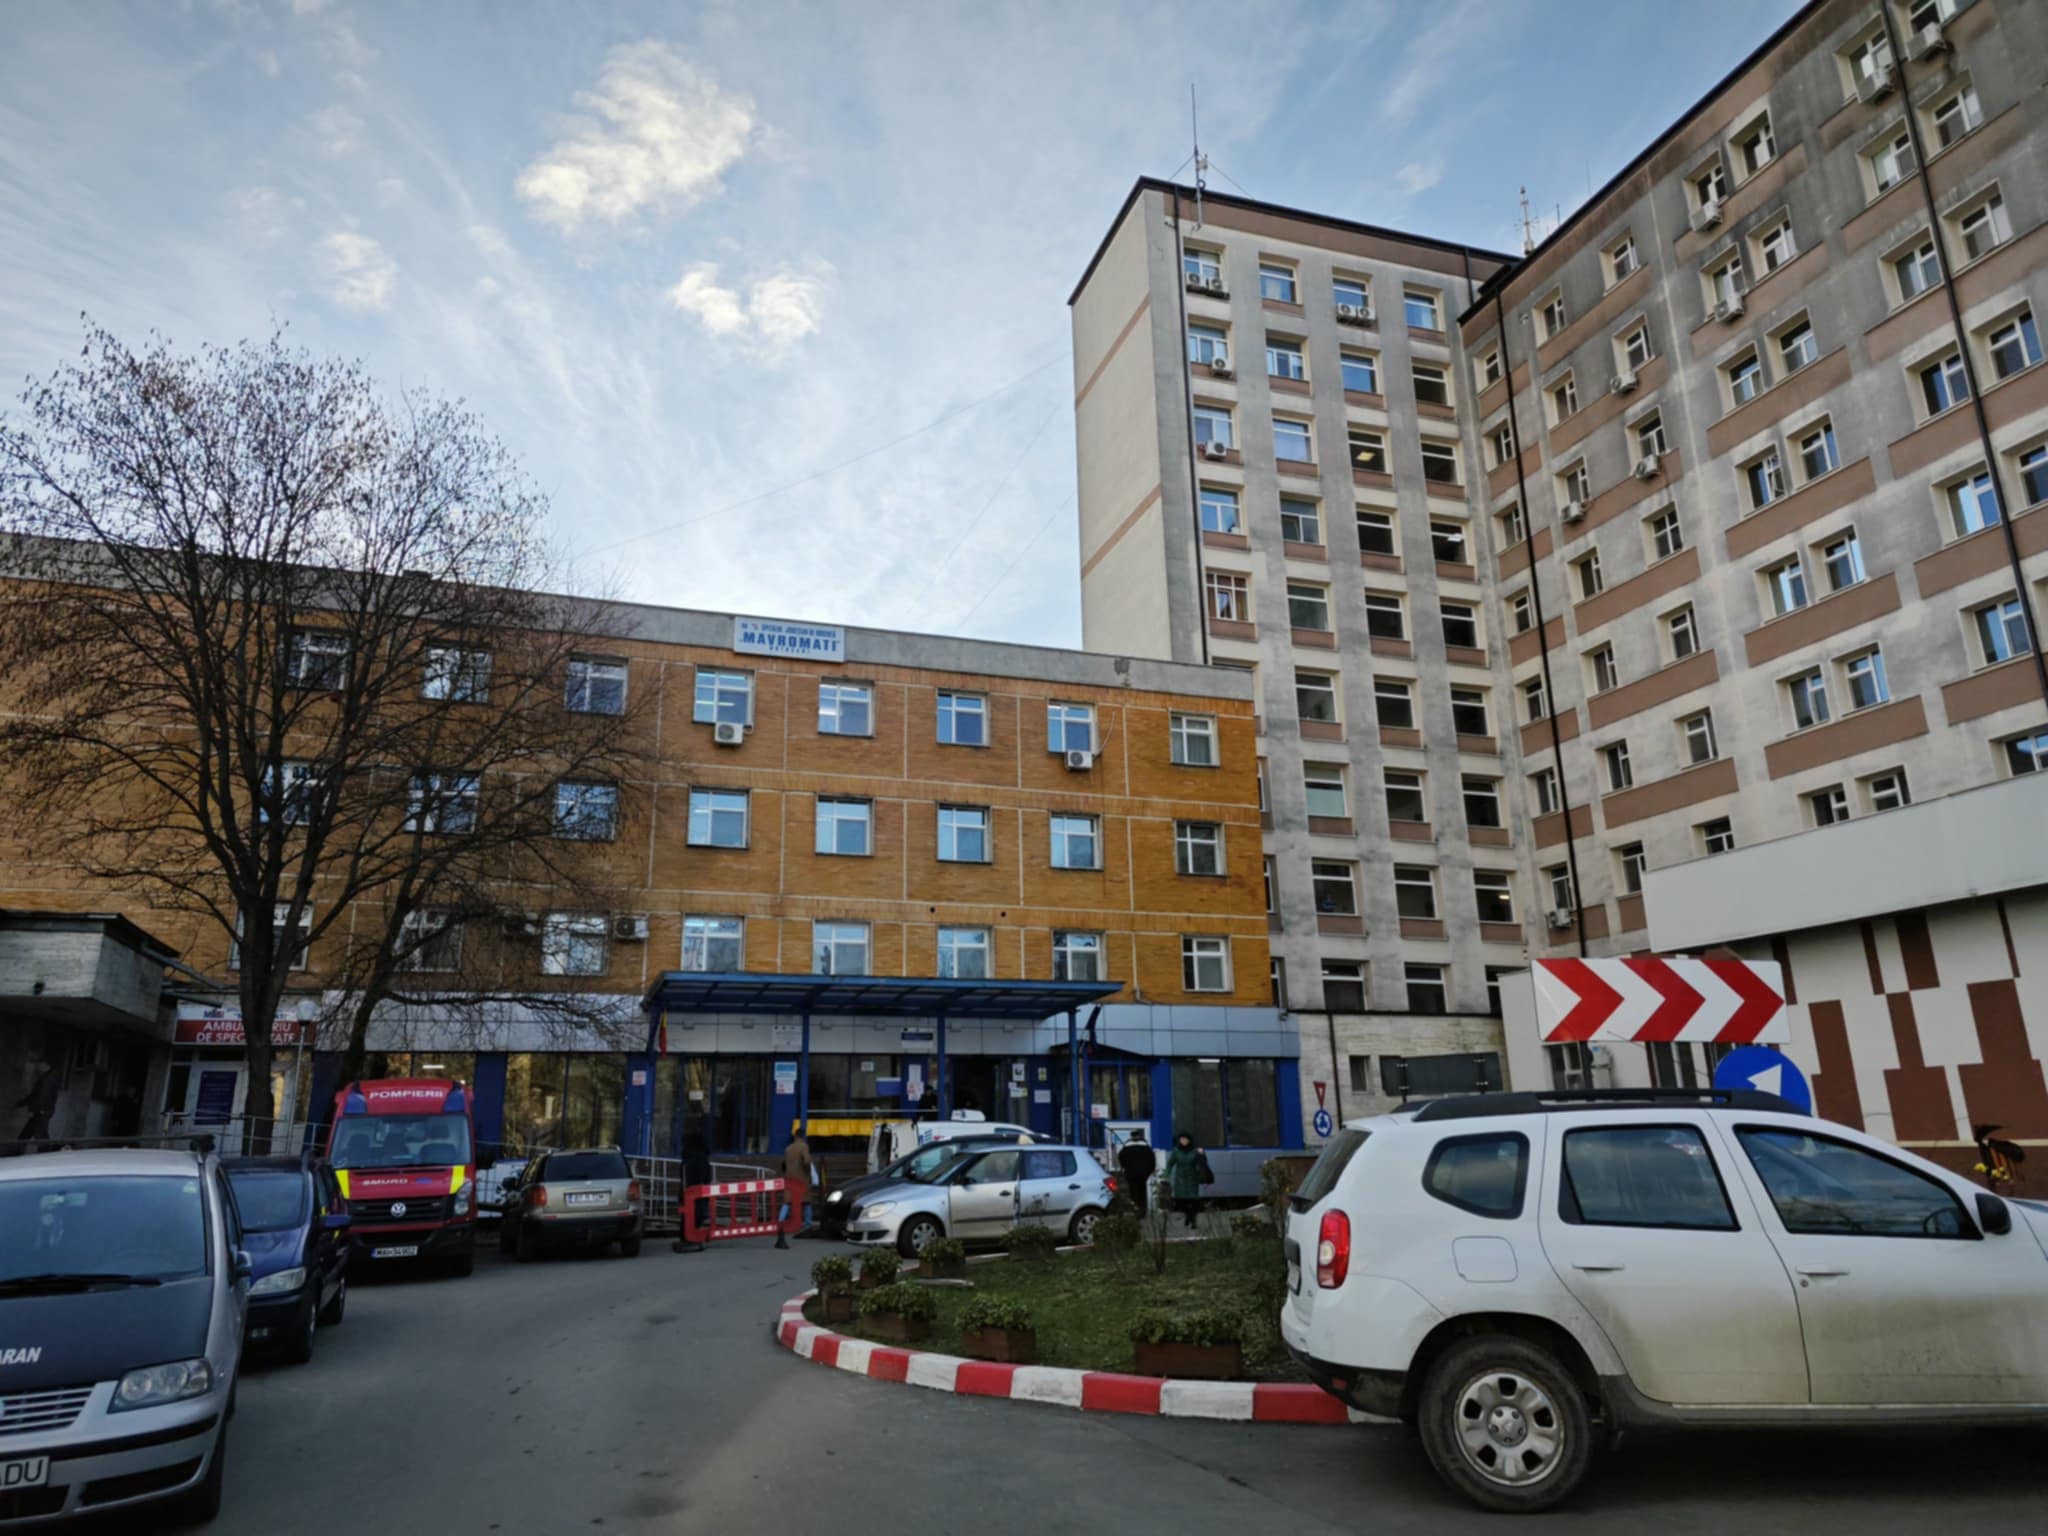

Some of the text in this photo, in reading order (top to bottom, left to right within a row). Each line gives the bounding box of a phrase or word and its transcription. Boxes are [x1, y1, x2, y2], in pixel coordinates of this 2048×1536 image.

[195, 1032, 213, 1042] DE
[369, 1090, 443, 1099] POMPIERII
[0, 1459, 43, 1486] DU
